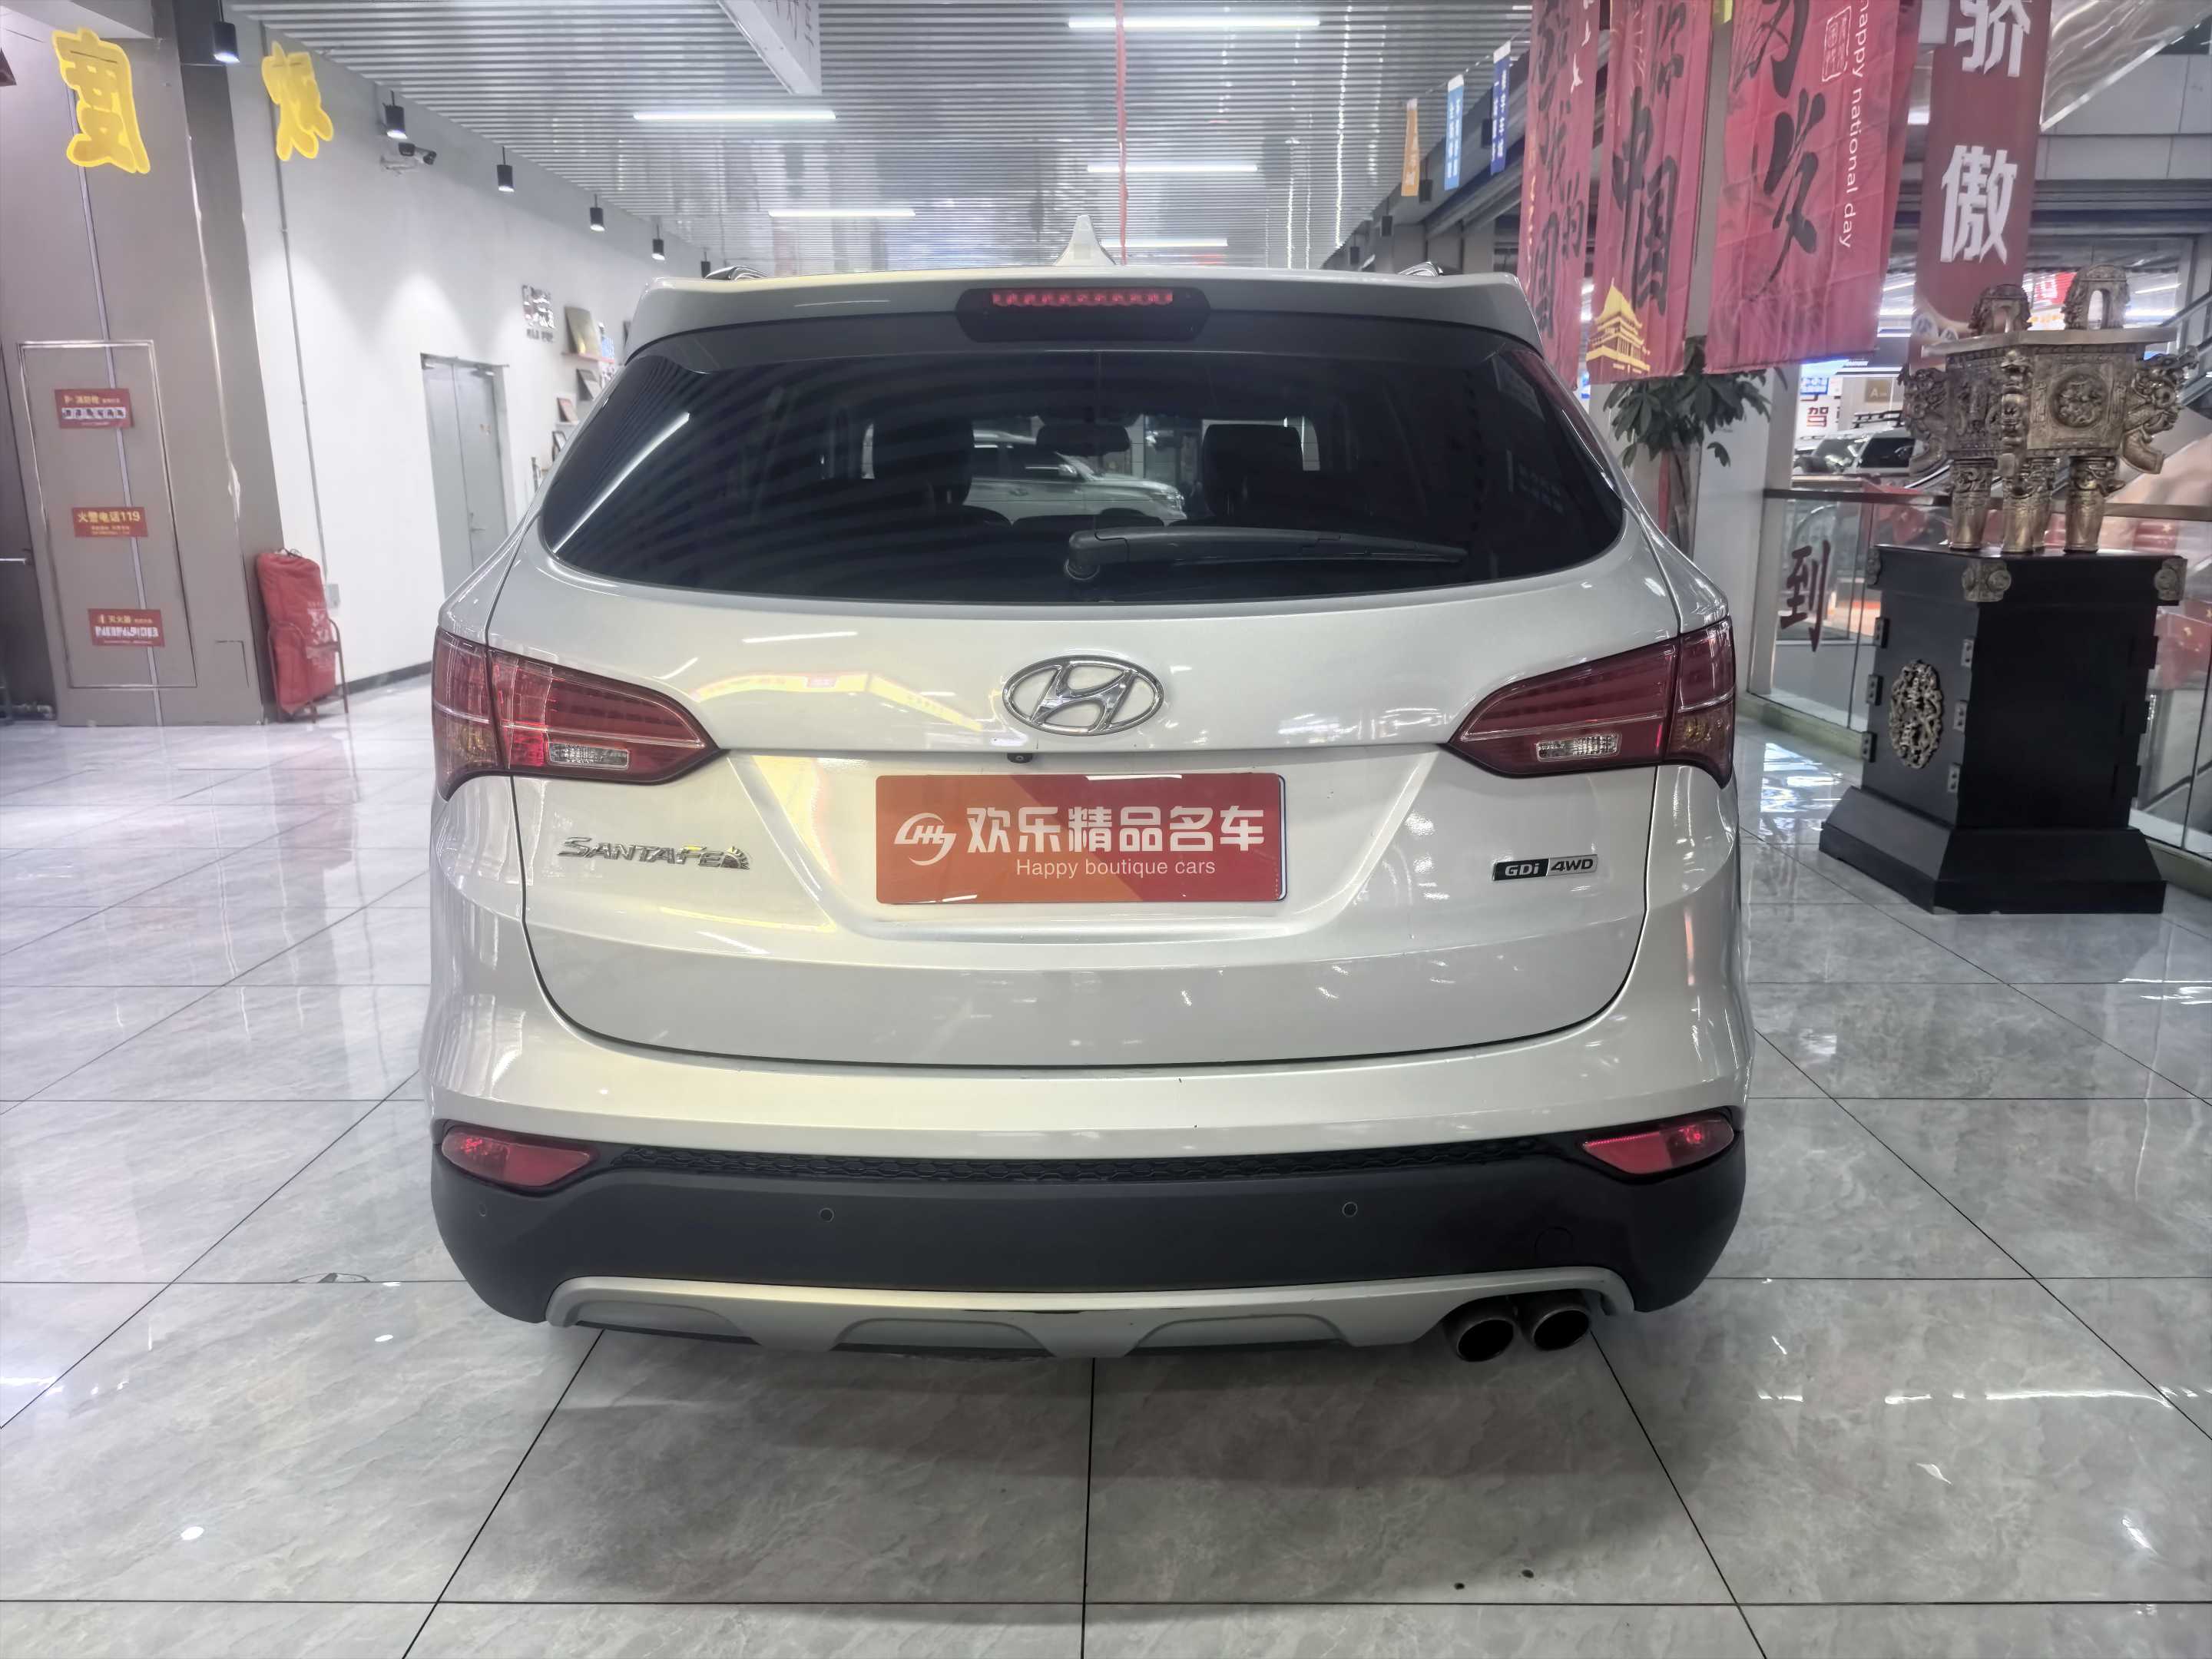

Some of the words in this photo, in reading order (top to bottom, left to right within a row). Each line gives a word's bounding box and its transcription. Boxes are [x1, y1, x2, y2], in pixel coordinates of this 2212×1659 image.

[1845, 88, 1863, 194] national
[1940, 0, 2032, 265] 骄傲
[1839, 203, 1856, 247] day
[1780, 539, 1832, 652] 到
[966, 805, 1265, 854] 欢乐精品名车
[1015, 859, 1078, 879] Happy
[1085, 858, 1169, 878] boutique
[1174, 859, 1216, 874] cars
[1550, 859, 1594, 872] 4WD
